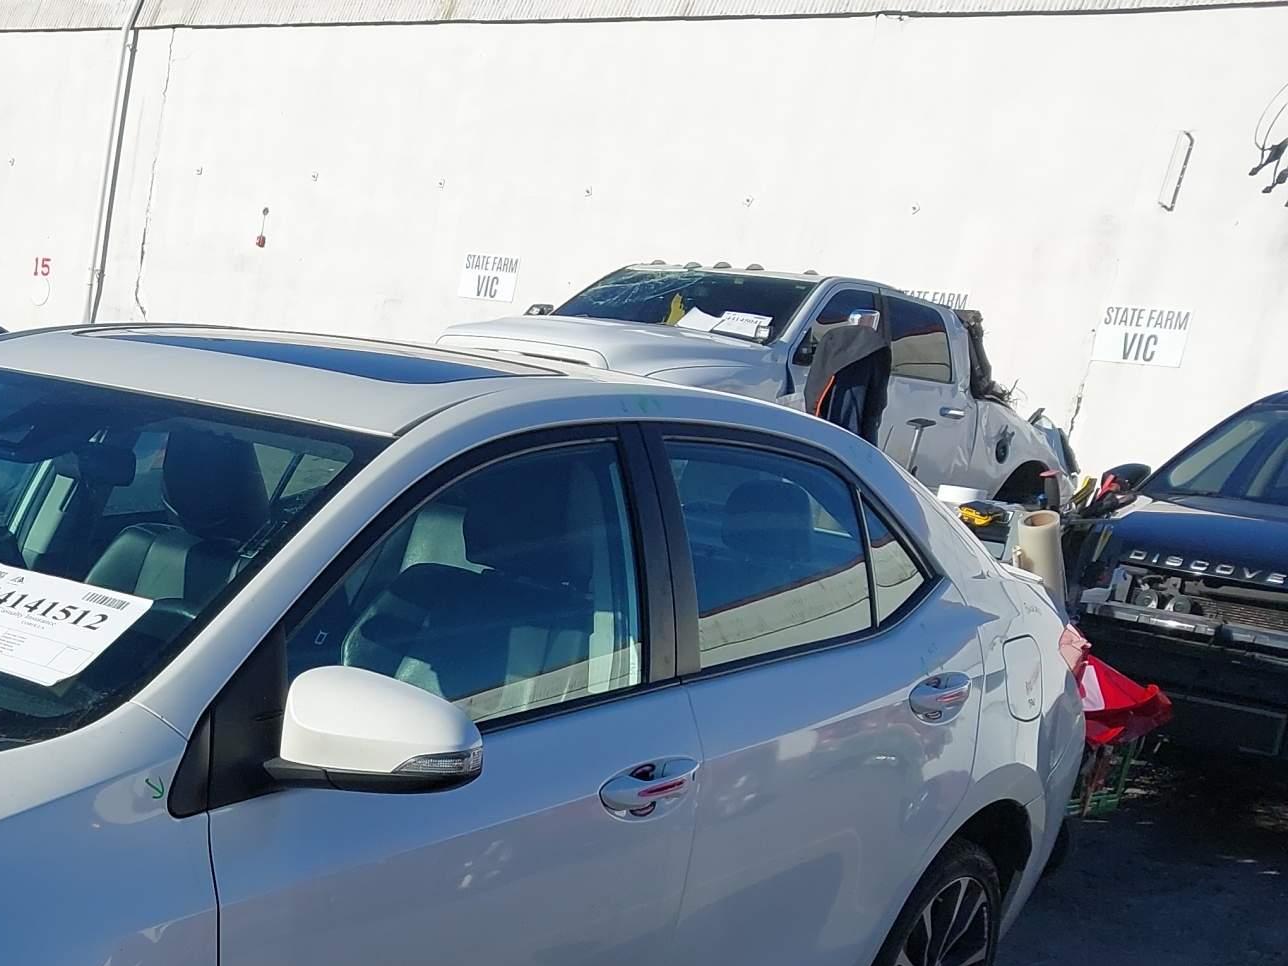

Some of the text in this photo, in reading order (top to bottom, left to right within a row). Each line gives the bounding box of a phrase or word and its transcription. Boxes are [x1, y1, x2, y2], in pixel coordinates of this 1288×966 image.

[33, 257, 51, 276] 15
[465, 254, 519, 273] STATE FARM
[476, 274, 499, 298] VIC
[1104, 306, 1191, 330] STATE FARM
[1122, 332, 1158, 362] VIC
